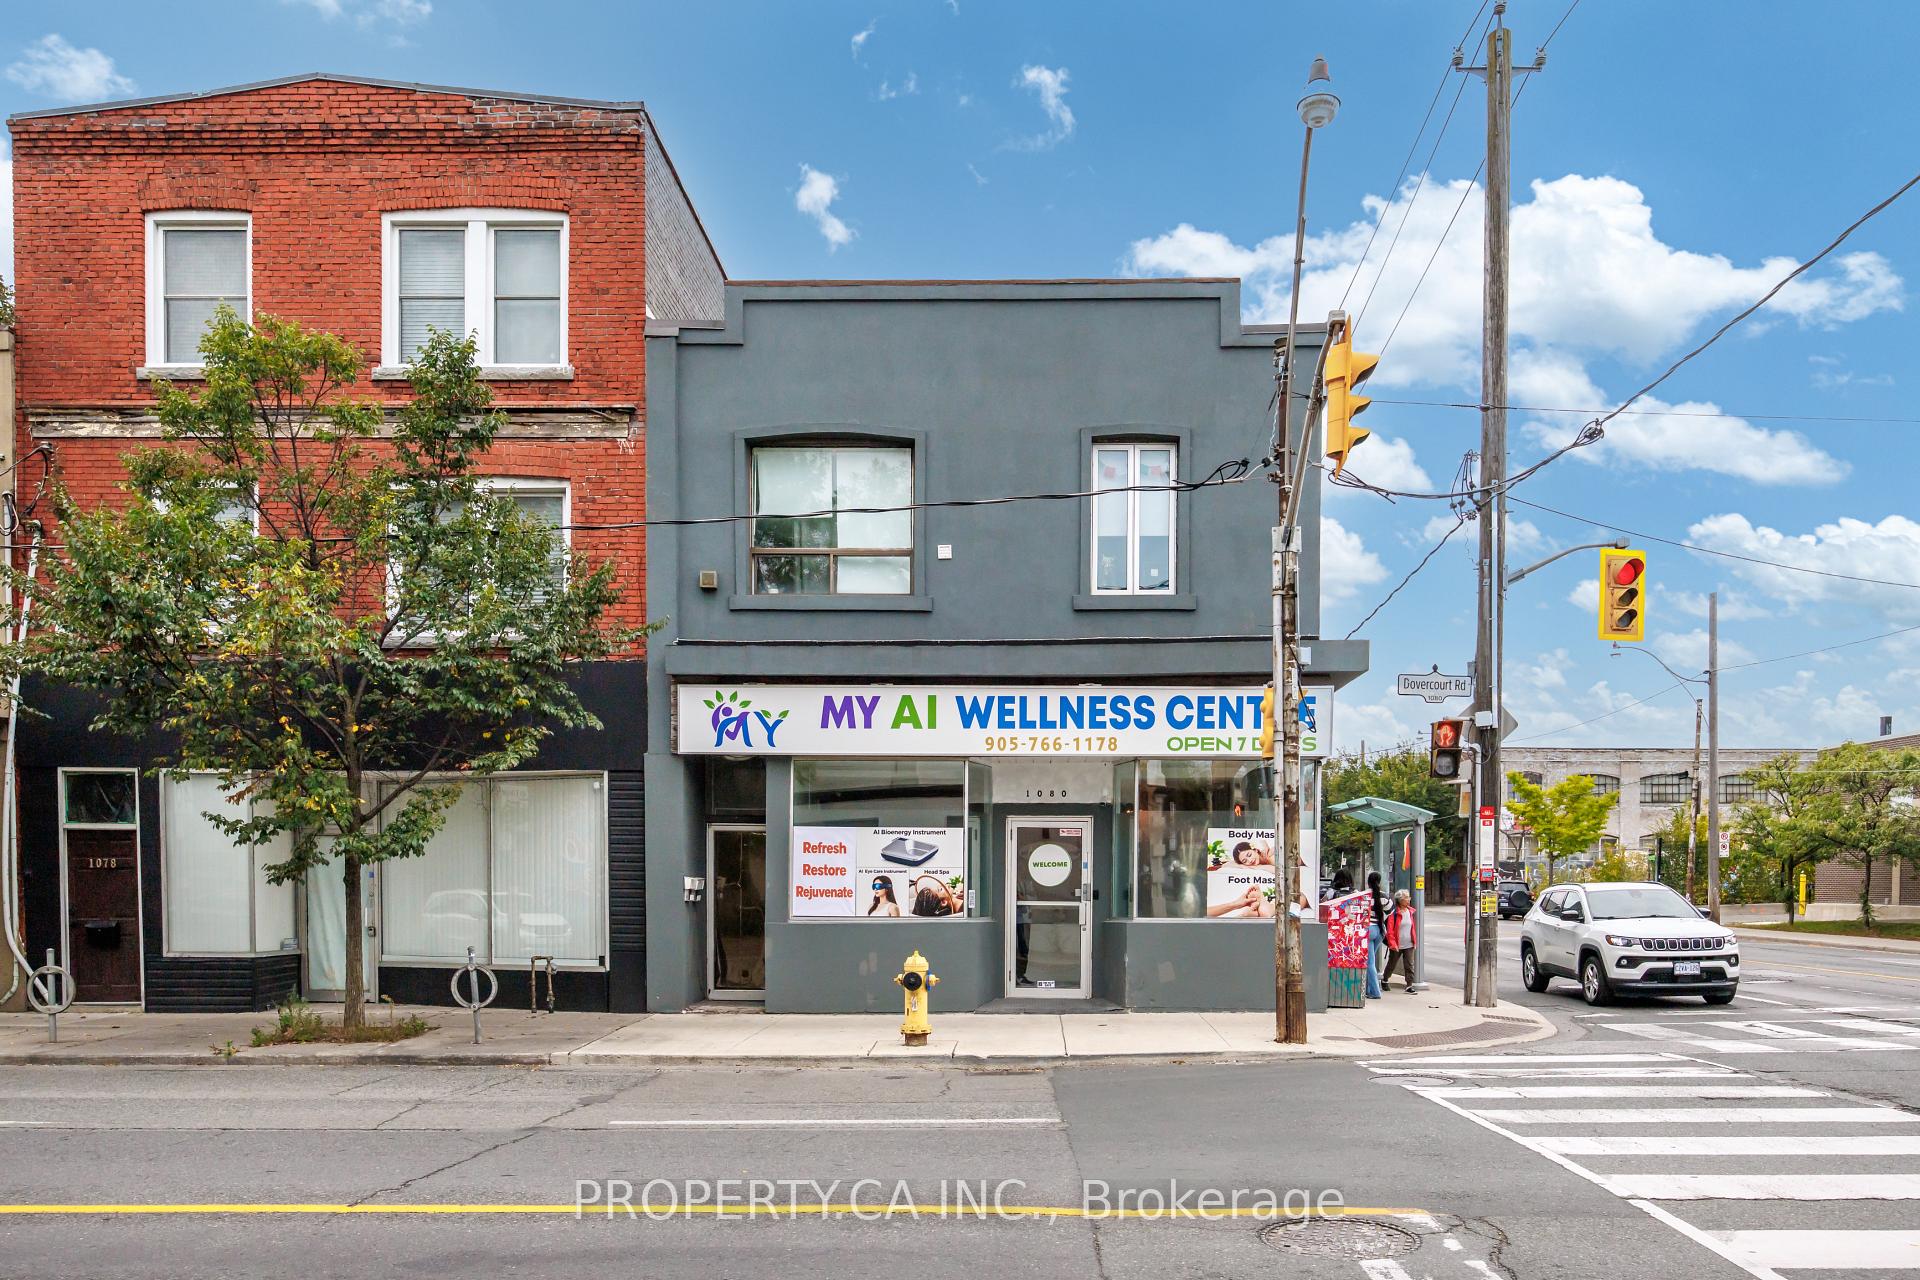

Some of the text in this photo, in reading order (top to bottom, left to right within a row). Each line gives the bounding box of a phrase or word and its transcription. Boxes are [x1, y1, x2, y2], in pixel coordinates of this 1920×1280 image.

[1403, 677, 1466, 690] Dovercourt Rd
[820, 694, 1317, 731] MY AI WELLNESS CENTE
[984, 736, 1118, 752] 905-766-1178
[1166, 736, 1232, 752] OPEN
[1237, 736, 1247, 752] 7
[1026, 789, 1067, 798] 1080
[880, 828, 912, 837] Bioenergy
[1228, 830, 1254, 840] Body
[802, 841, 847, 854] Refresh
[89, 858, 117, 868] 1078
[802, 863, 847, 876] Restore
[1228, 876, 1251, 884] Foot
[795, 885, 854, 900] Rejuvenate
